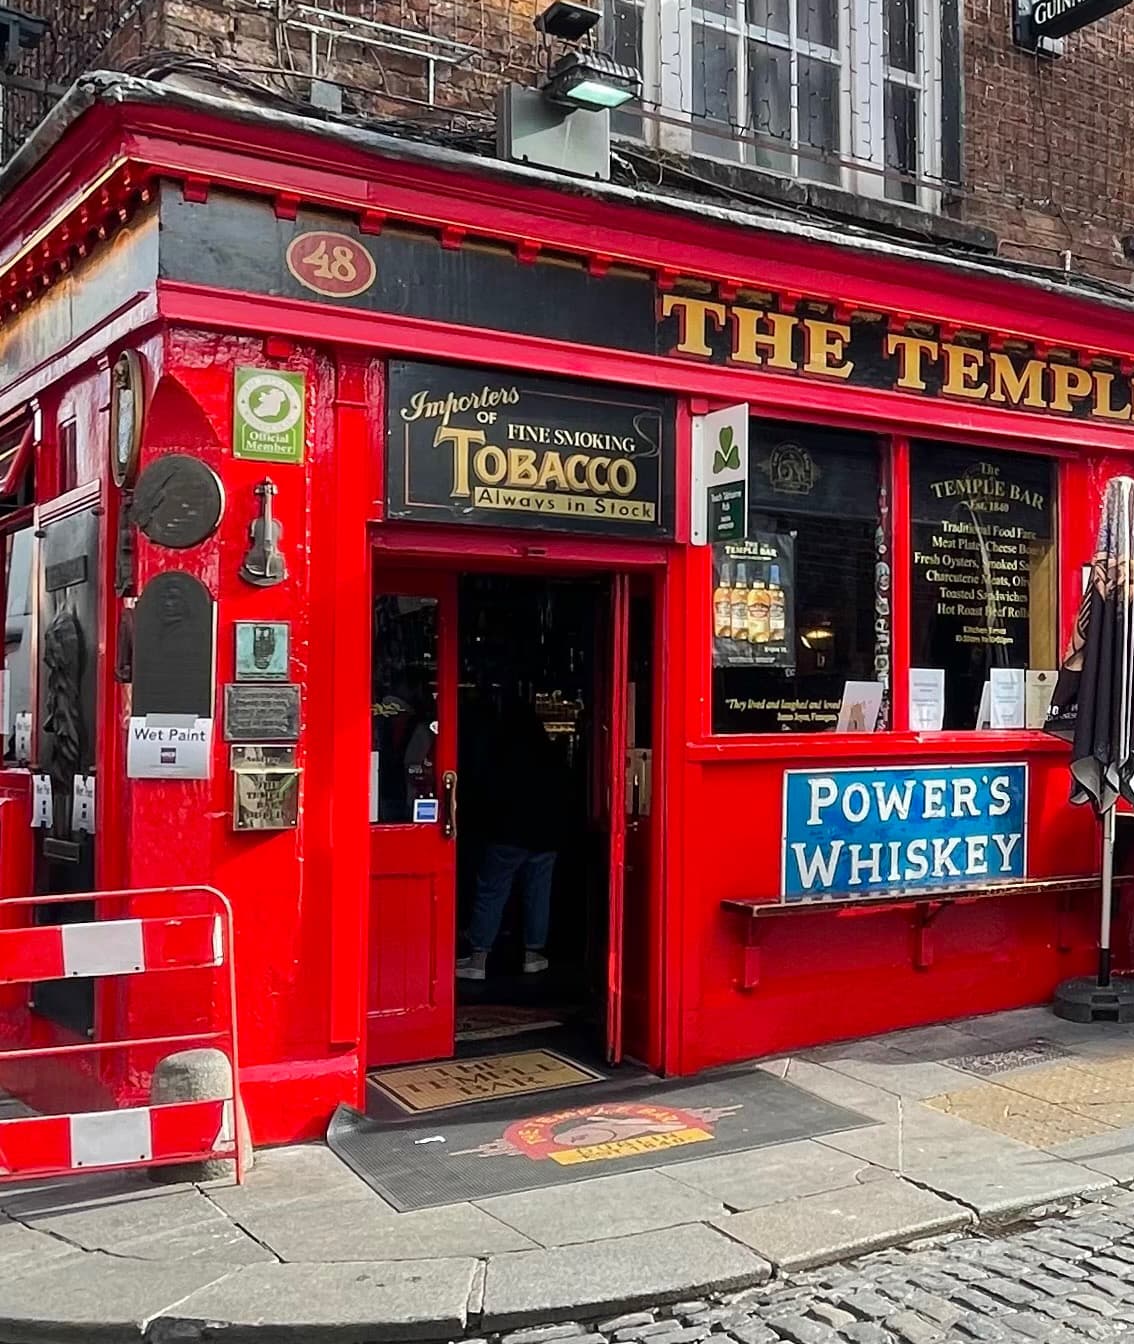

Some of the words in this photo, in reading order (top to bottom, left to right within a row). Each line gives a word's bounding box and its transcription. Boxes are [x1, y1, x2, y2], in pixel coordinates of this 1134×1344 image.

[302, 239, 357, 283] 48
[660, 294, 855, 380] THE
[400, 385, 520, 425] Importers
[476, 410, 497, 425] OF
[245, 440, 294, 454] Member
[249, 431, 289, 444] Official
[507, 423, 550, 444] FINE
[553, 429, 636, 454] SMOKING
[433, 425, 638, 498] TOBACCO
[980, 462, 1001, 476] The
[477, 487, 555, 511] Always
[567, 496, 585, 513] in
[593, 499, 653, 520] Stock
[930, 478, 1007, 498] TEMPLE
[1009, 484, 1045, 511] BAR
[941, 519, 992, 537] Traditional
[993, 525, 1017, 539] Food
[931, 535, 957, 549] Meat
[984, 540, 1018, 555] Cheese
[913, 551, 941, 565] Fresh
[941, 554, 980, 569] Oysters,
[925, 569, 979, 583] Charcuterie
[940, 586, 975, 600] Toasted
[976, 588, 1028, 603] Sandwiches
[936, 602, 955, 615] Hot
[956, 604, 983, 616] Roast
[984, 605, 1007, 618] Beef
[134, 727, 164, 742] Wet
[168, 728, 207, 743] Paint
[806, 775, 1012, 826] POWER'S
[790, 833, 1022, 889] WHISKEY
[392, 1061, 567, 1094] TEMPLE
